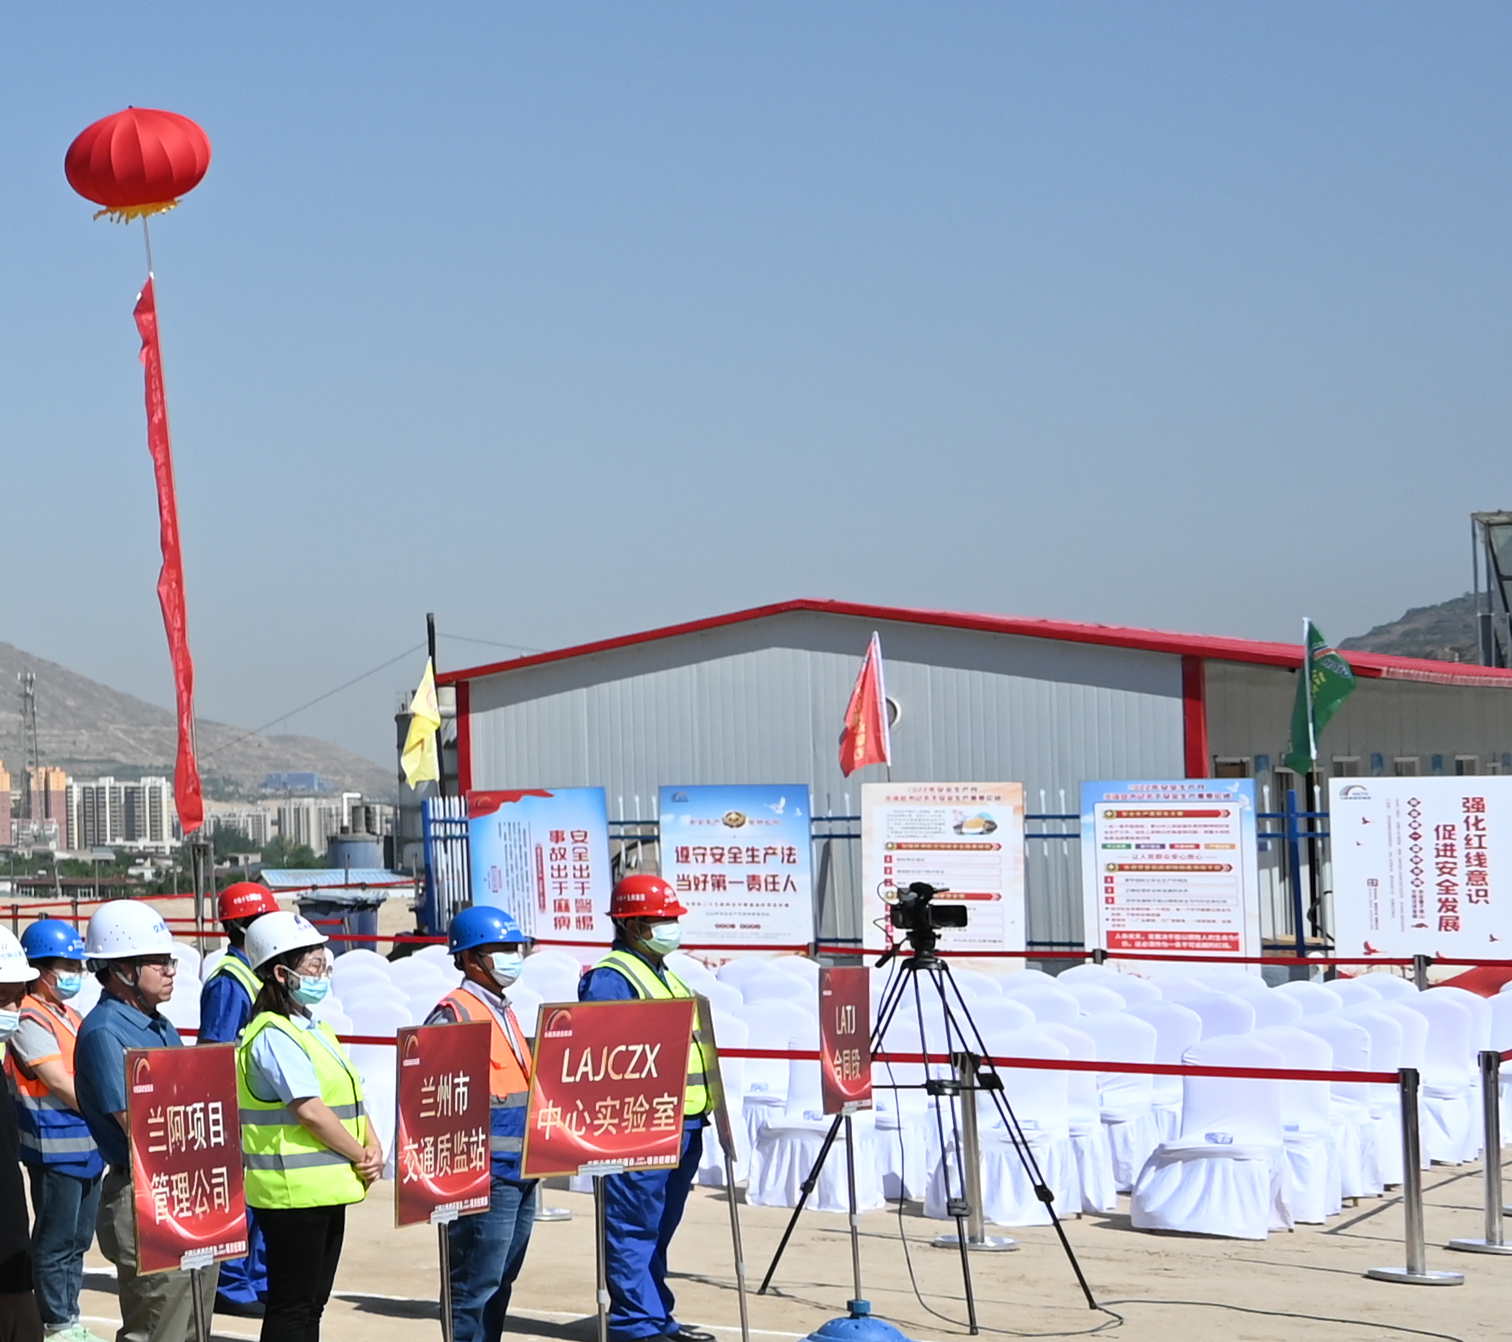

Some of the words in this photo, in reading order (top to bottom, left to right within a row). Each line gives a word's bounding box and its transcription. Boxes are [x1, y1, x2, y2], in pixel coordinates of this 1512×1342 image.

[675, 845, 797, 865] 遵守安全生产法
[1462, 796, 1490, 905] 强化红线意识
[549, 829, 571, 931] 事故出于麻痹
[569, 829, 594, 931] 安全出于警惕
[676, 873, 797, 893] 当好第一责任人
[1434, 823, 1461, 932] 促进安全发展
[835, 1005, 856, 1035] LATJ
[561, 1042, 662, 1084] LAJCZX
[833, 1047, 862, 1083] 合同段
[419, 1069, 470, 1119] 兰州市
[537, 1091, 679, 1141] 中心实验室
[147, 1101, 226, 1153] 兰阿项目
[402, 1126, 487, 1185] 交通质监站
[151, 1166, 231, 1225] 管理公司
